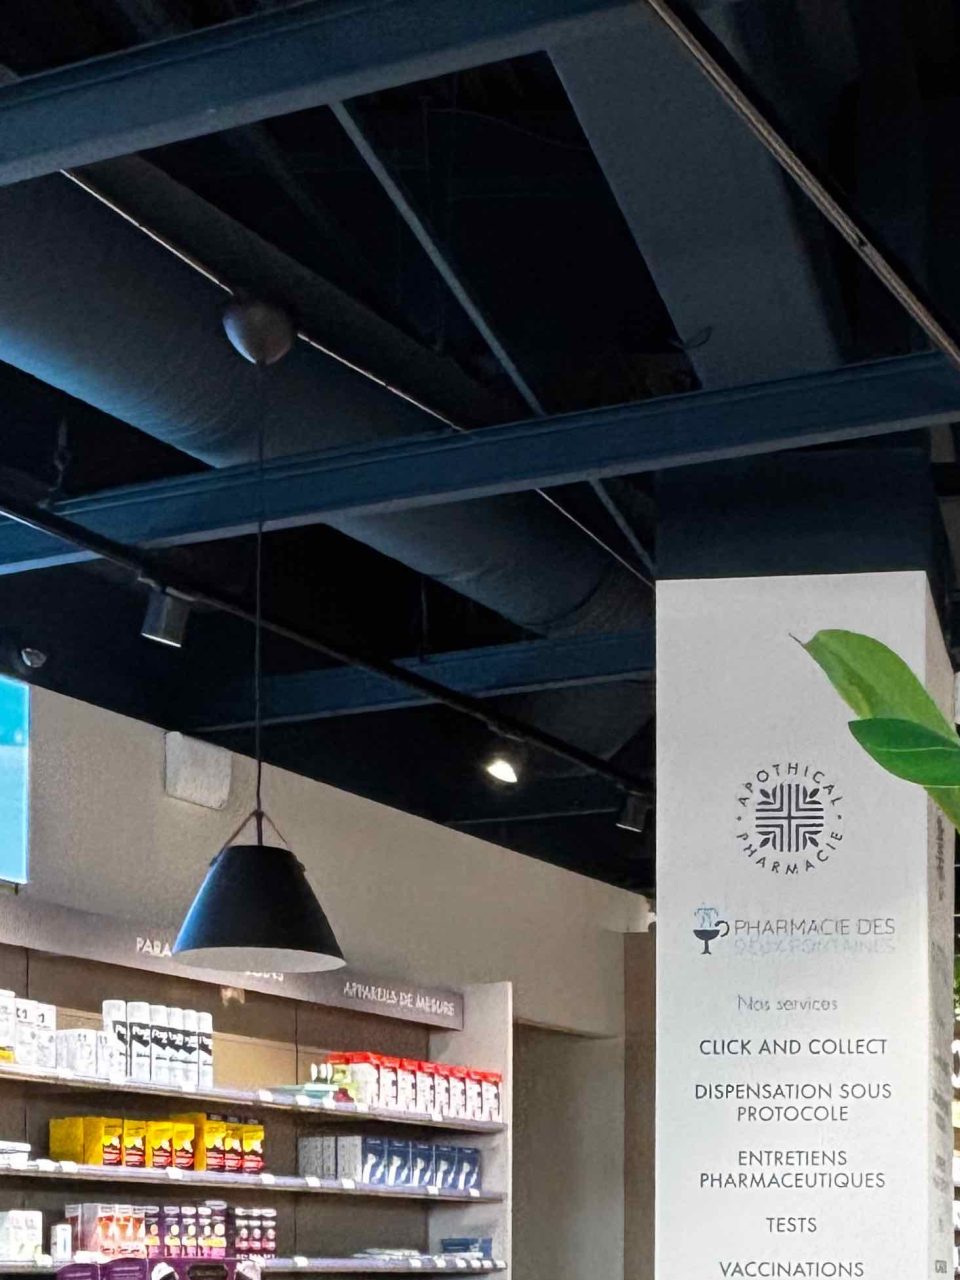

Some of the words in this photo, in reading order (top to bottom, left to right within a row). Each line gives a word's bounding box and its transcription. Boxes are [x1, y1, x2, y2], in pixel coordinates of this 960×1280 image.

[738, 762, 843, 807] APOTHICAL
[736, 831, 843, 875] PHARMACIE
[734, 918, 850, 936] PHARMACIE
[857, 918, 896, 936] DES
[399, 991, 414, 1008] DE
[416, 994, 455, 1017] MESURE
[737, 994, 770, 1011] Nos
[776, 996, 838, 1011] services
[699, 1039, 752, 1056] CLICK
[758, 1039, 801, 1055] AND
[808, 1038, 888, 1055] COLLECT
[695, 1083, 832, 1100] DISPENSATION
[839, 1083, 892, 1099] SOUS
[737, 1105, 849, 1122] PROTOCOLE
[738, 1150, 848, 1166] ENTRETIENS
[700, 1172, 886, 1189] PHARMACEUTIQUES
[766, 1217, 818, 1233] TESTS
[719, 1261, 865, 1278] VACCINATIONS
